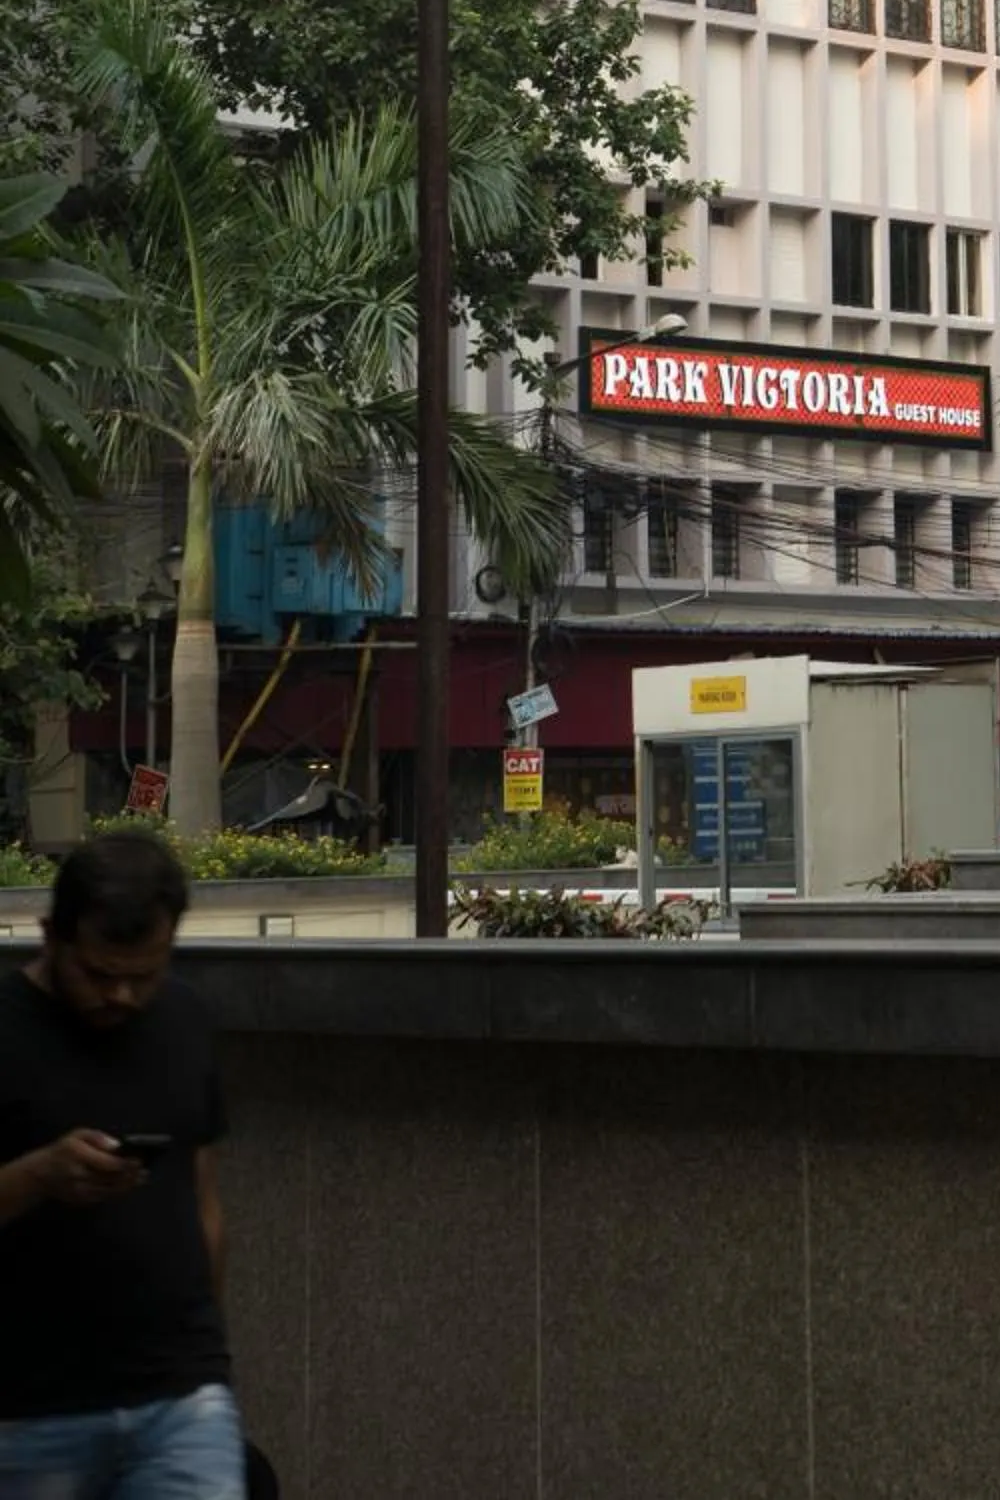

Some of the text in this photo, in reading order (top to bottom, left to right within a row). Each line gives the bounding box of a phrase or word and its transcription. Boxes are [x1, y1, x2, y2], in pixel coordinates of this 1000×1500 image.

[603, 352, 982, 427] PARK VICTORIA GUEST HOUSE
[507, 757, 540, 773] CAT
